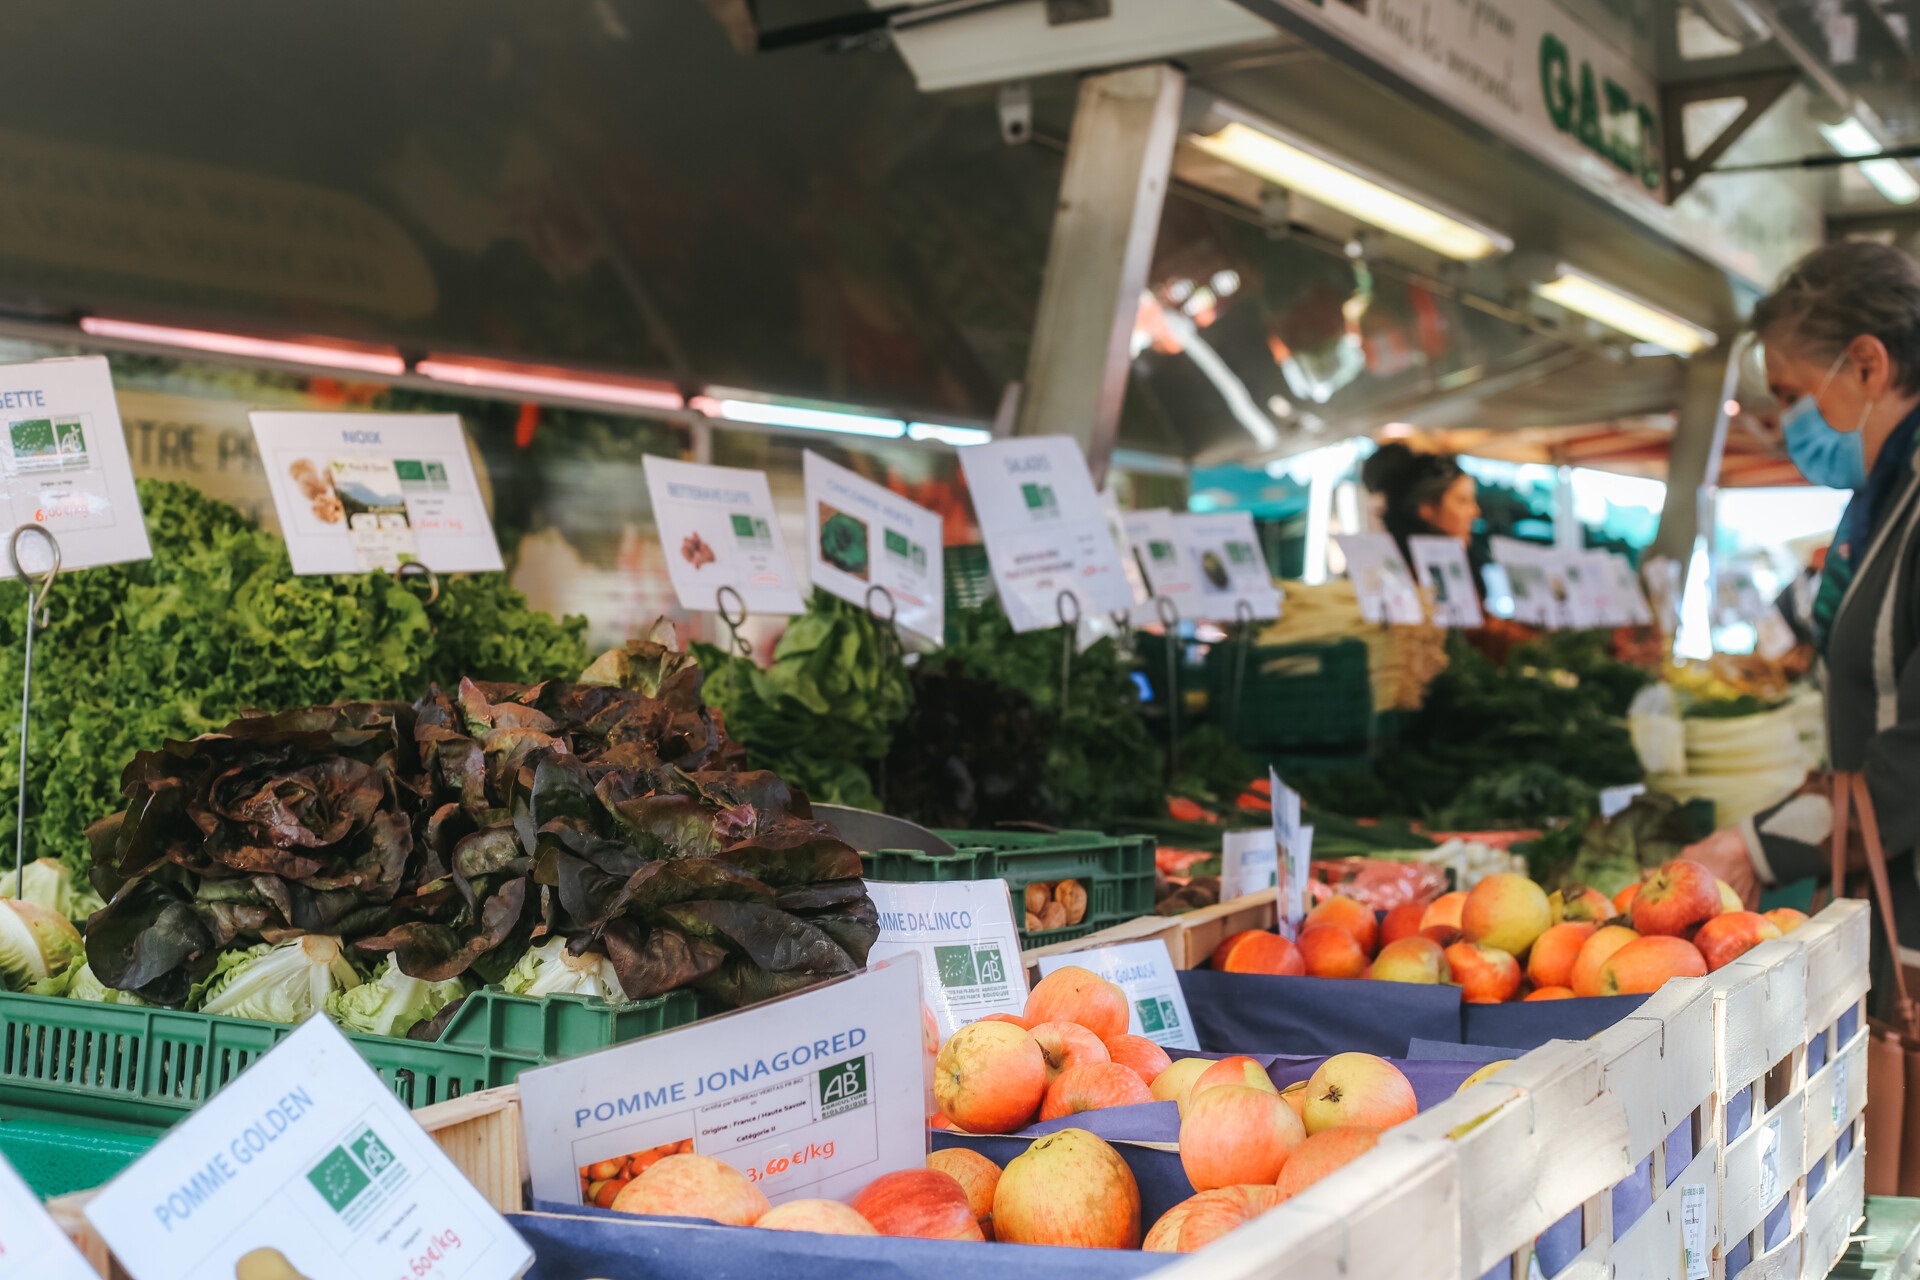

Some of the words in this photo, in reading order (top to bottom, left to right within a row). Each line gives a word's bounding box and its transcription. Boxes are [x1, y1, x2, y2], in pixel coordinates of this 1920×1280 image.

[908, 910, 972, 932] DALINCO
[981, 960, 1002, 984] AB
[575, 1081, 687, 1129] POMME
[693, 1027, 867, 1098] JONAGORED
[823, 1070, 860, 1104] AB
[821, 1092, 867, 1111] AGRICULTURE
[821, 1098, 868, 1118] BIOLOGIQUE
[702, 1125, 728, 1136] Origine
[733, 1116, 756, 1127] France
[761, 1107, 782, 1118] Haute
[784, 1100, 806, 1111] Savoie
[736, 1127, 770, 1143] Catégorie
[153, 1152, 237, 1232] POMME
[230, 1084, 315, 1164] GOLDEN
